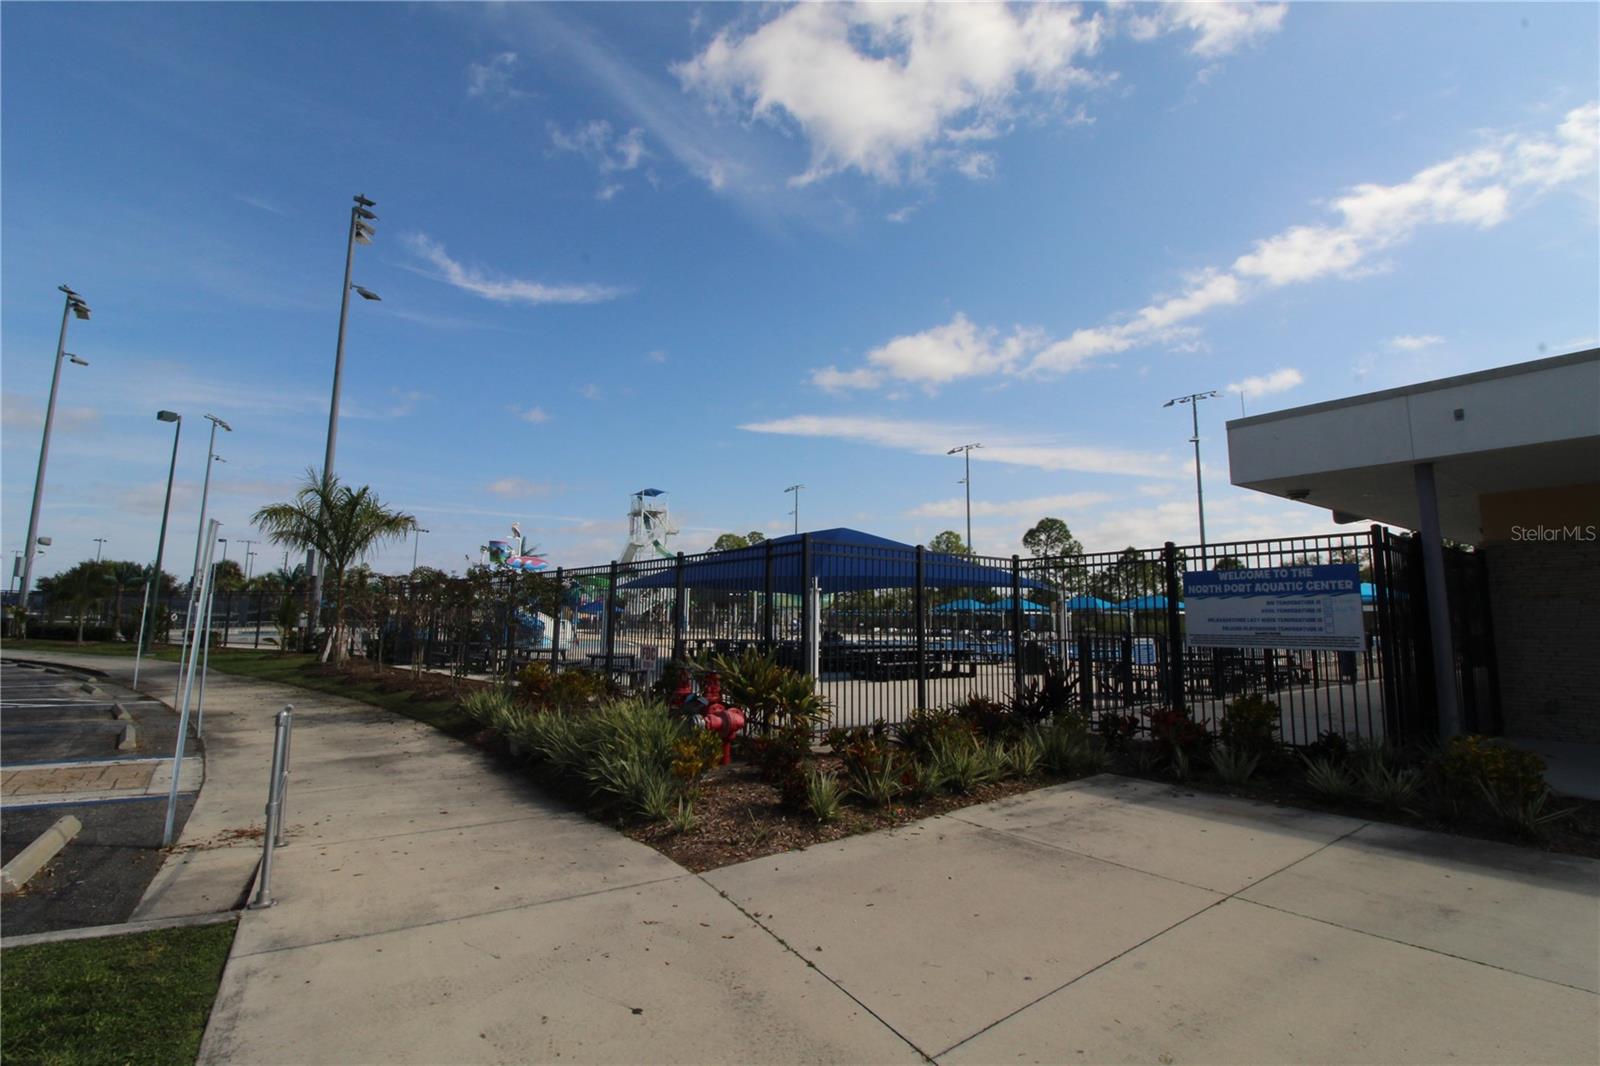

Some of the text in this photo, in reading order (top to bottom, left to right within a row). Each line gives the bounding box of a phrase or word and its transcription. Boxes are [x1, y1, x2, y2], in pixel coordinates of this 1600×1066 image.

[1218, 567, 1313, 580] WELCOME TO THE
[1188, 580, 1353, 594] NORTH PORT AQUATIC CENTER
